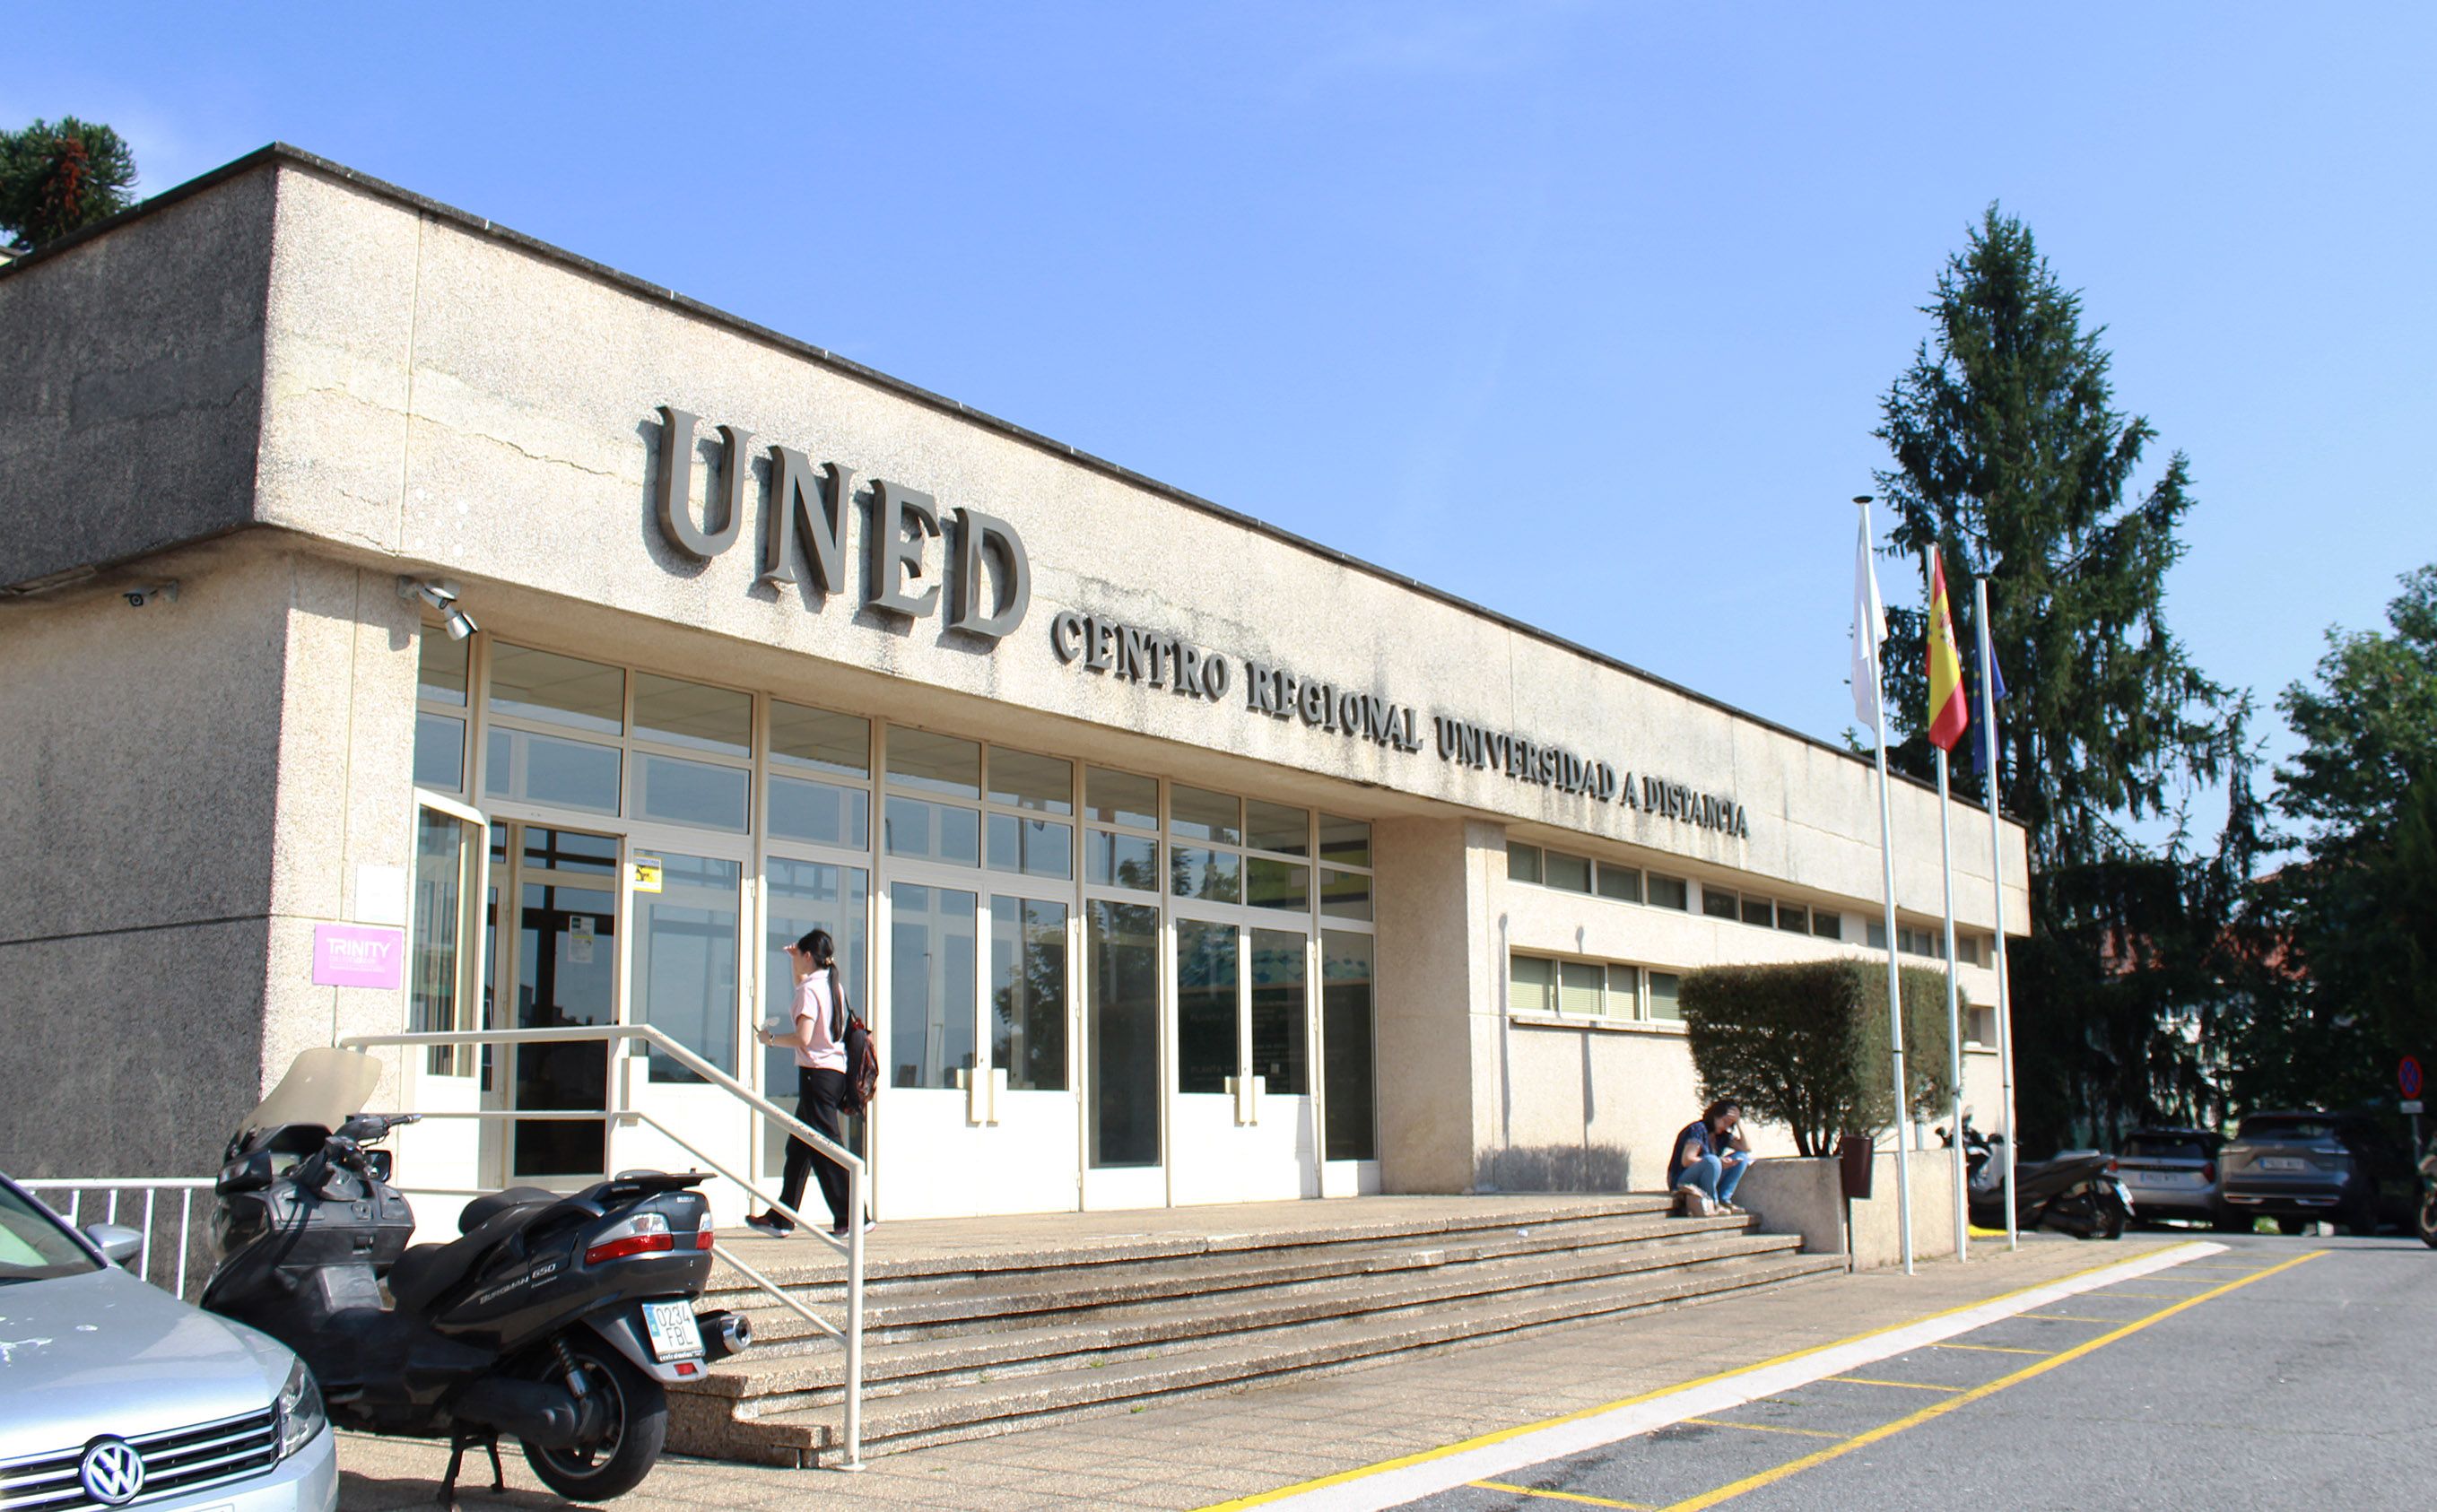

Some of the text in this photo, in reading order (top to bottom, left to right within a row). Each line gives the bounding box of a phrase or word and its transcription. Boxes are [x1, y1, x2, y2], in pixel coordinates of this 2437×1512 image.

[653, 405, 1031, 637] UNED
[1051, 610, 1750, 839] CENTRO REGIONAL UNIVERSIDAD A DISTANCIA
[326, 937, 391, 959] TRINITY
[532, 1262, 556, 1279] 650
[656, 1305, 691, 1327] 0234
[666, 1326, 693, 1347] FBL
